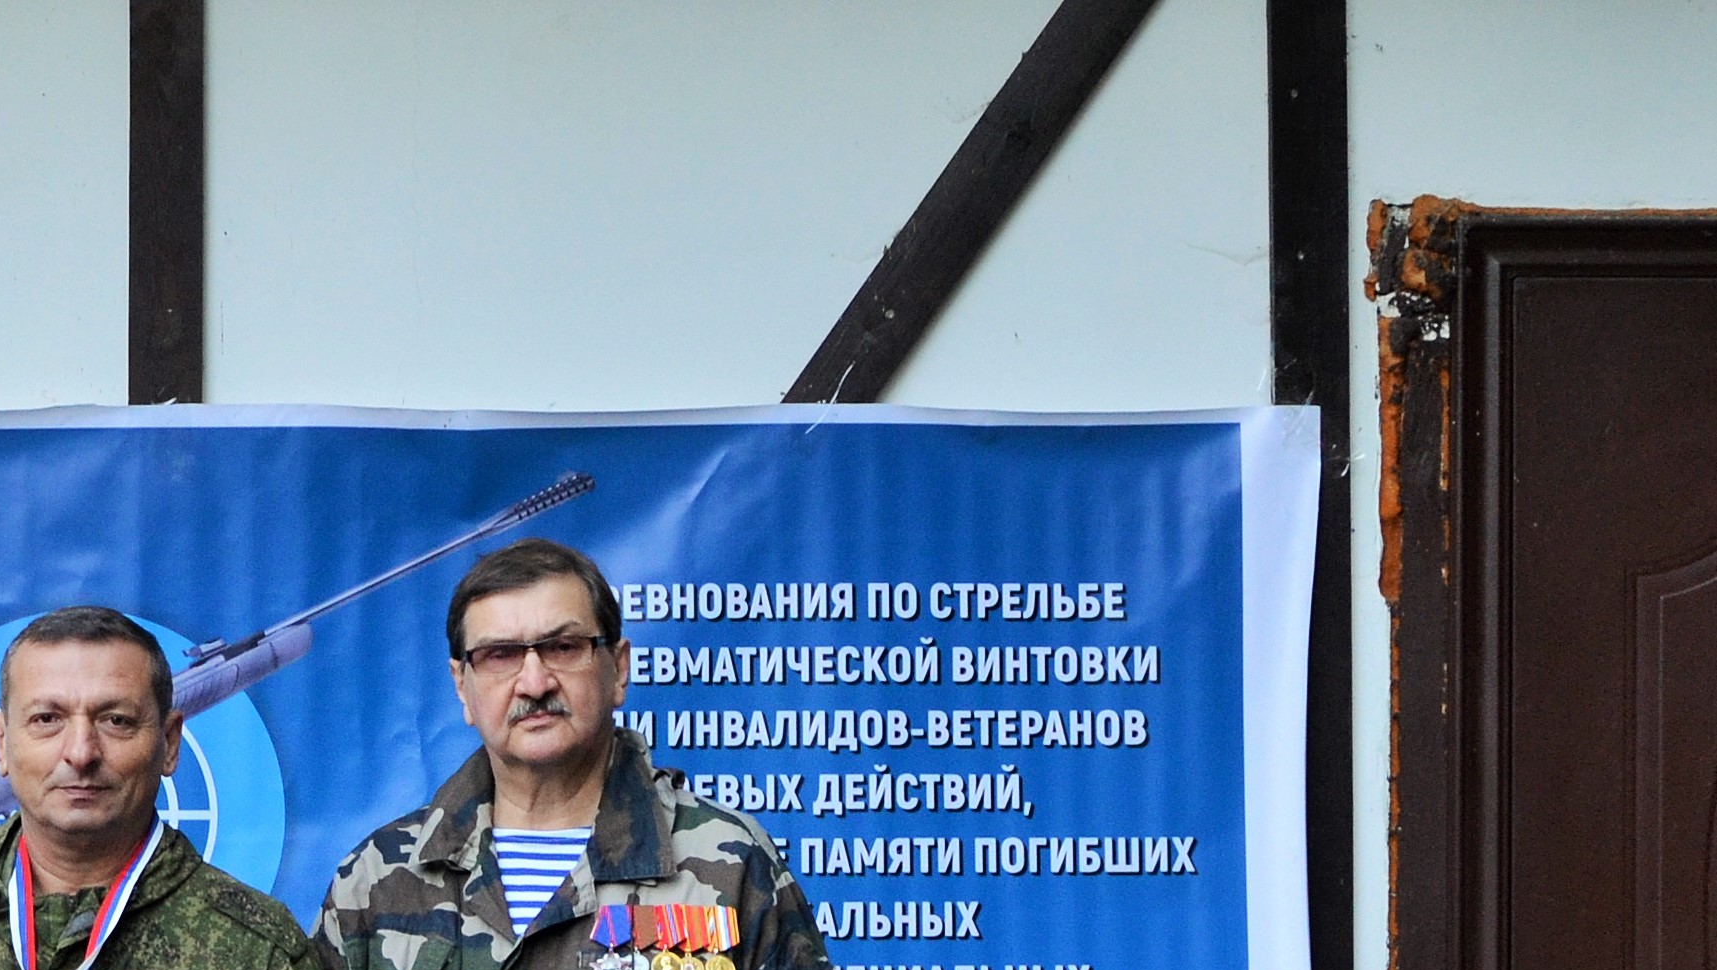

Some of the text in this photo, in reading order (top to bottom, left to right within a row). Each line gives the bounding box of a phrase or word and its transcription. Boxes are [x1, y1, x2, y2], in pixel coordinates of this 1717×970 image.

[614, 582, 1125, 619] ЕВНОВАНИЯ ПО СТРЕЛЬБЕ
[630, 636, 1159, 683] ЕВМАТИЧЕСКОЙ ВИНТОВКИ
[667, 709, 1148, 751] ИНВАЛИДОВ-ВЕТЕРАНОВ
[684, 764, 1032, 816] ЕВЫХ ДЕЙСТВИЙ,
[800, 838, 961, 874] ПАМЯТИ
[974, 837, 1196, 874] ПОГИБШИХ
[814, 902, 981, 938] АЛЬНЫХ
